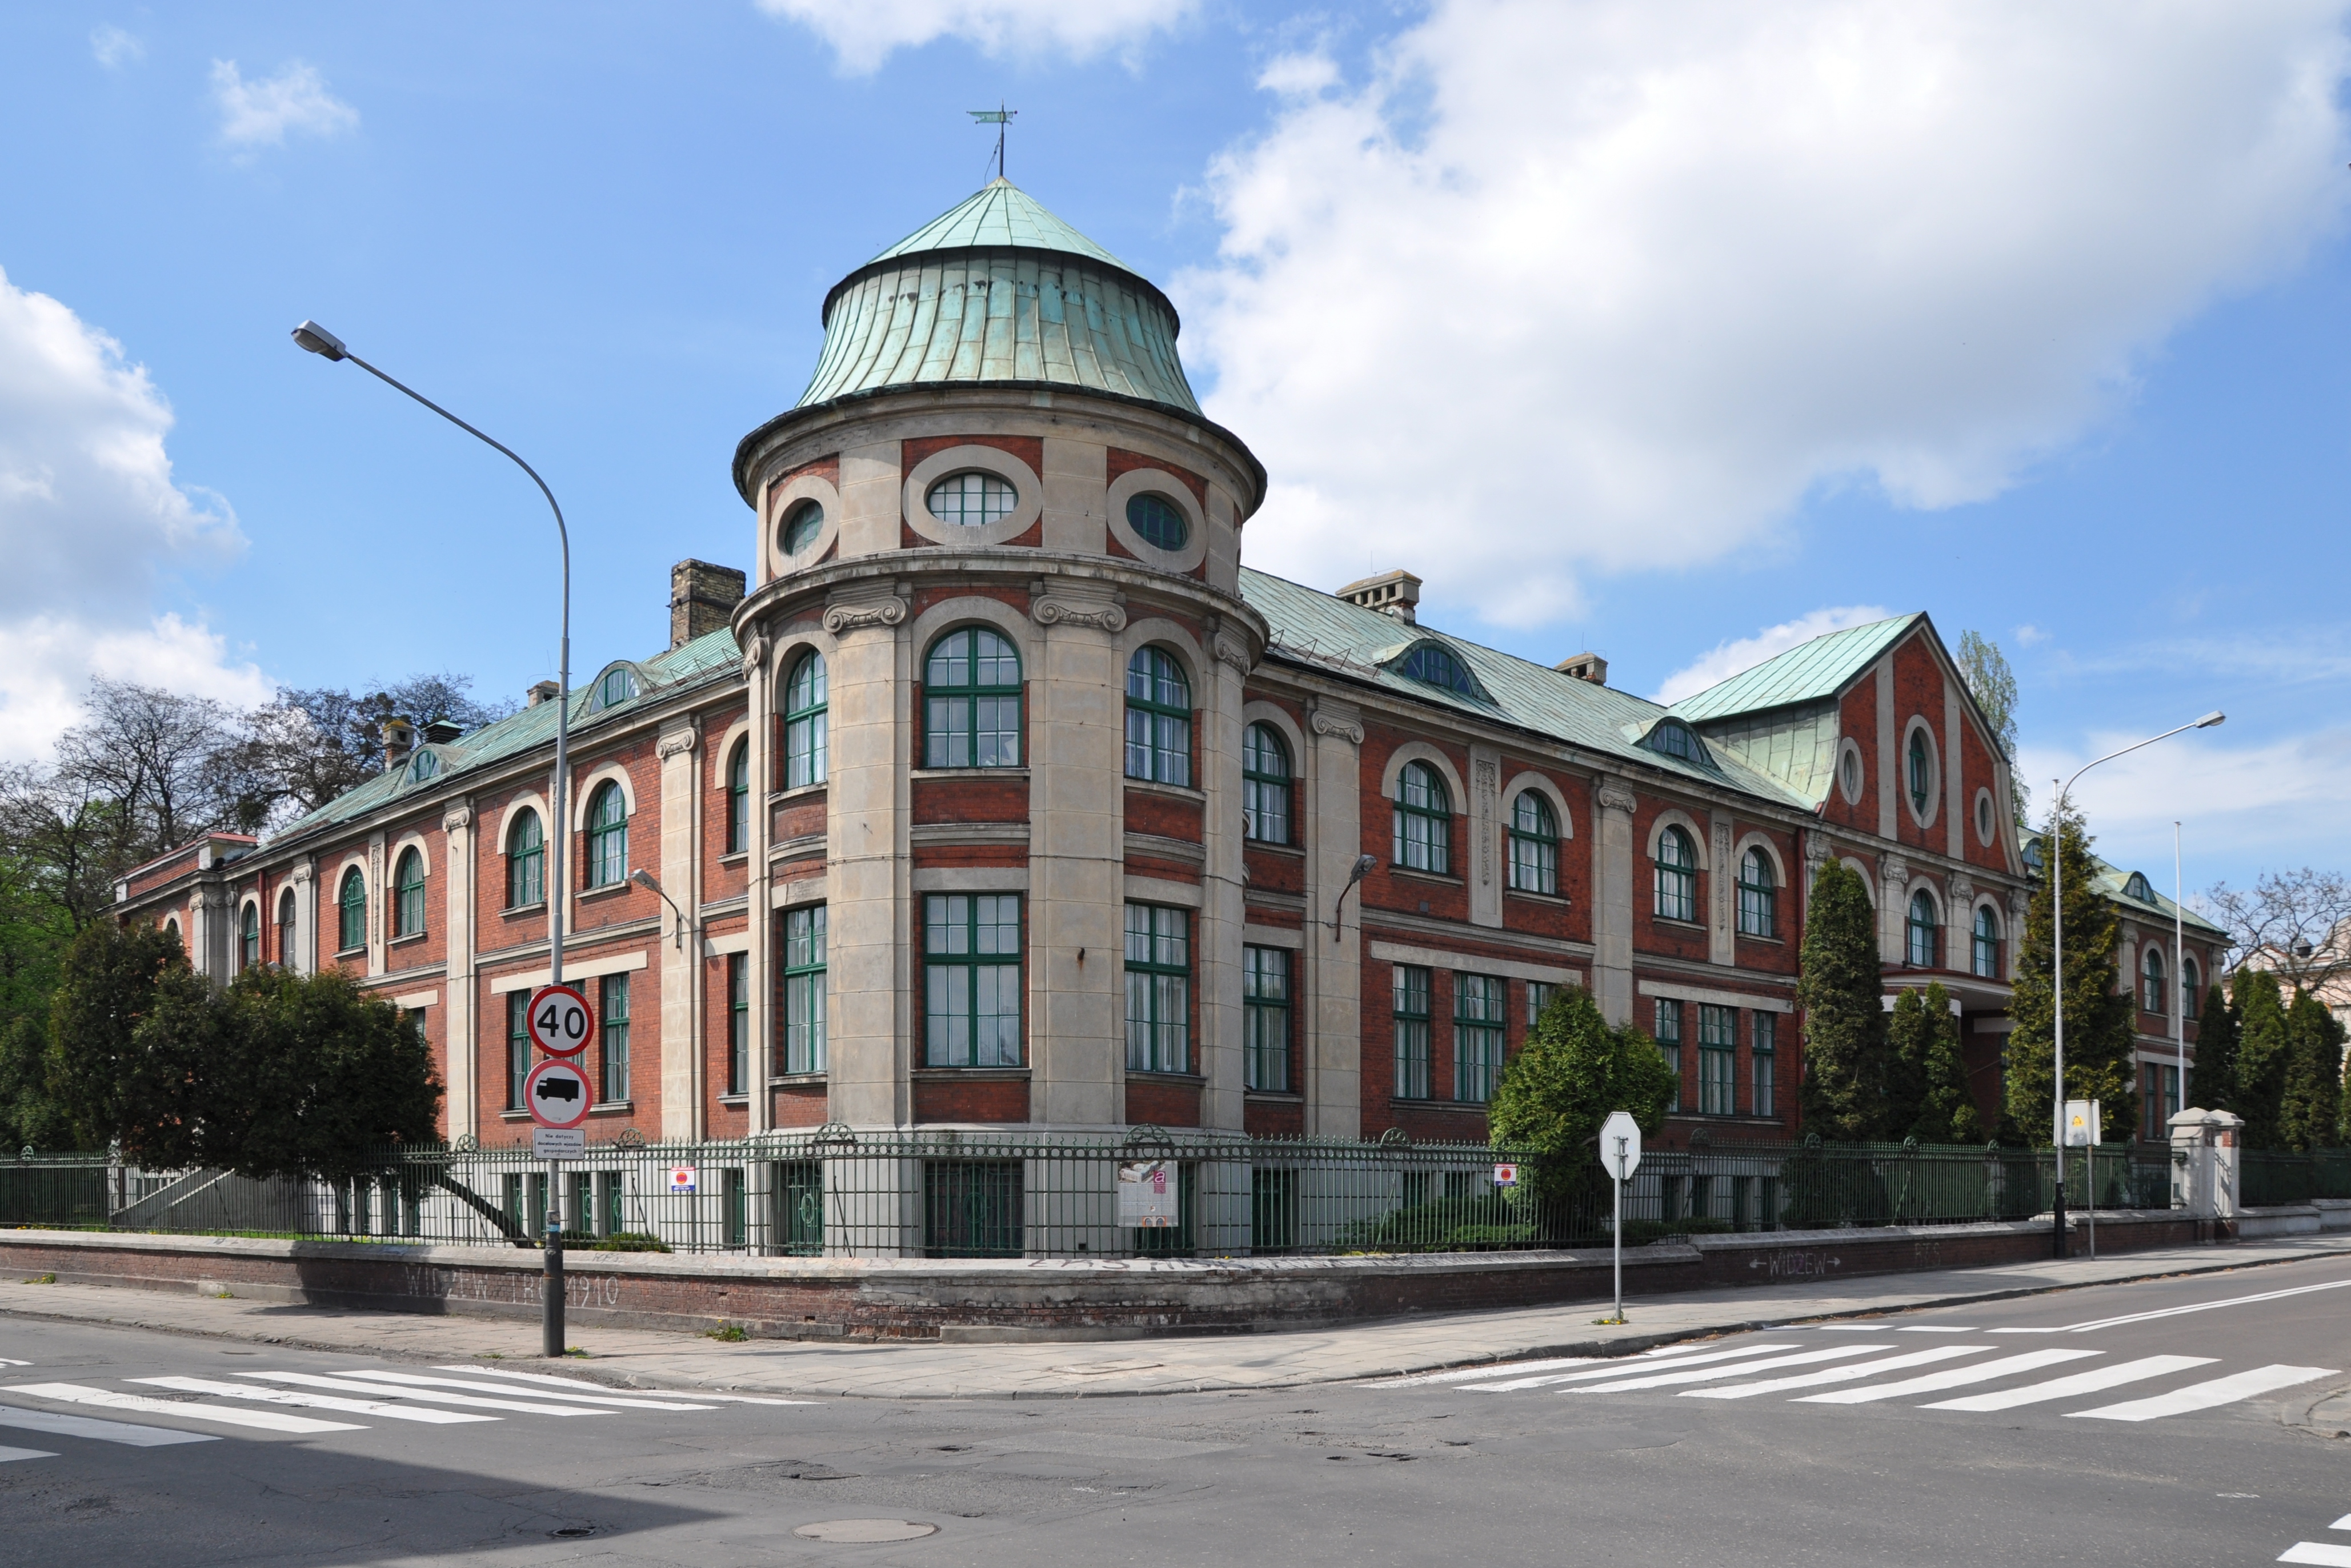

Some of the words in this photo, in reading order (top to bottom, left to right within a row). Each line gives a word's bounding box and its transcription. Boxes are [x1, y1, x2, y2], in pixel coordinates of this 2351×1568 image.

[537, 1004, 585, 1039] 40
[1769, 1252, 1827, 1276] WIDZEW
[567, 1275, 618, 1308] 1910
